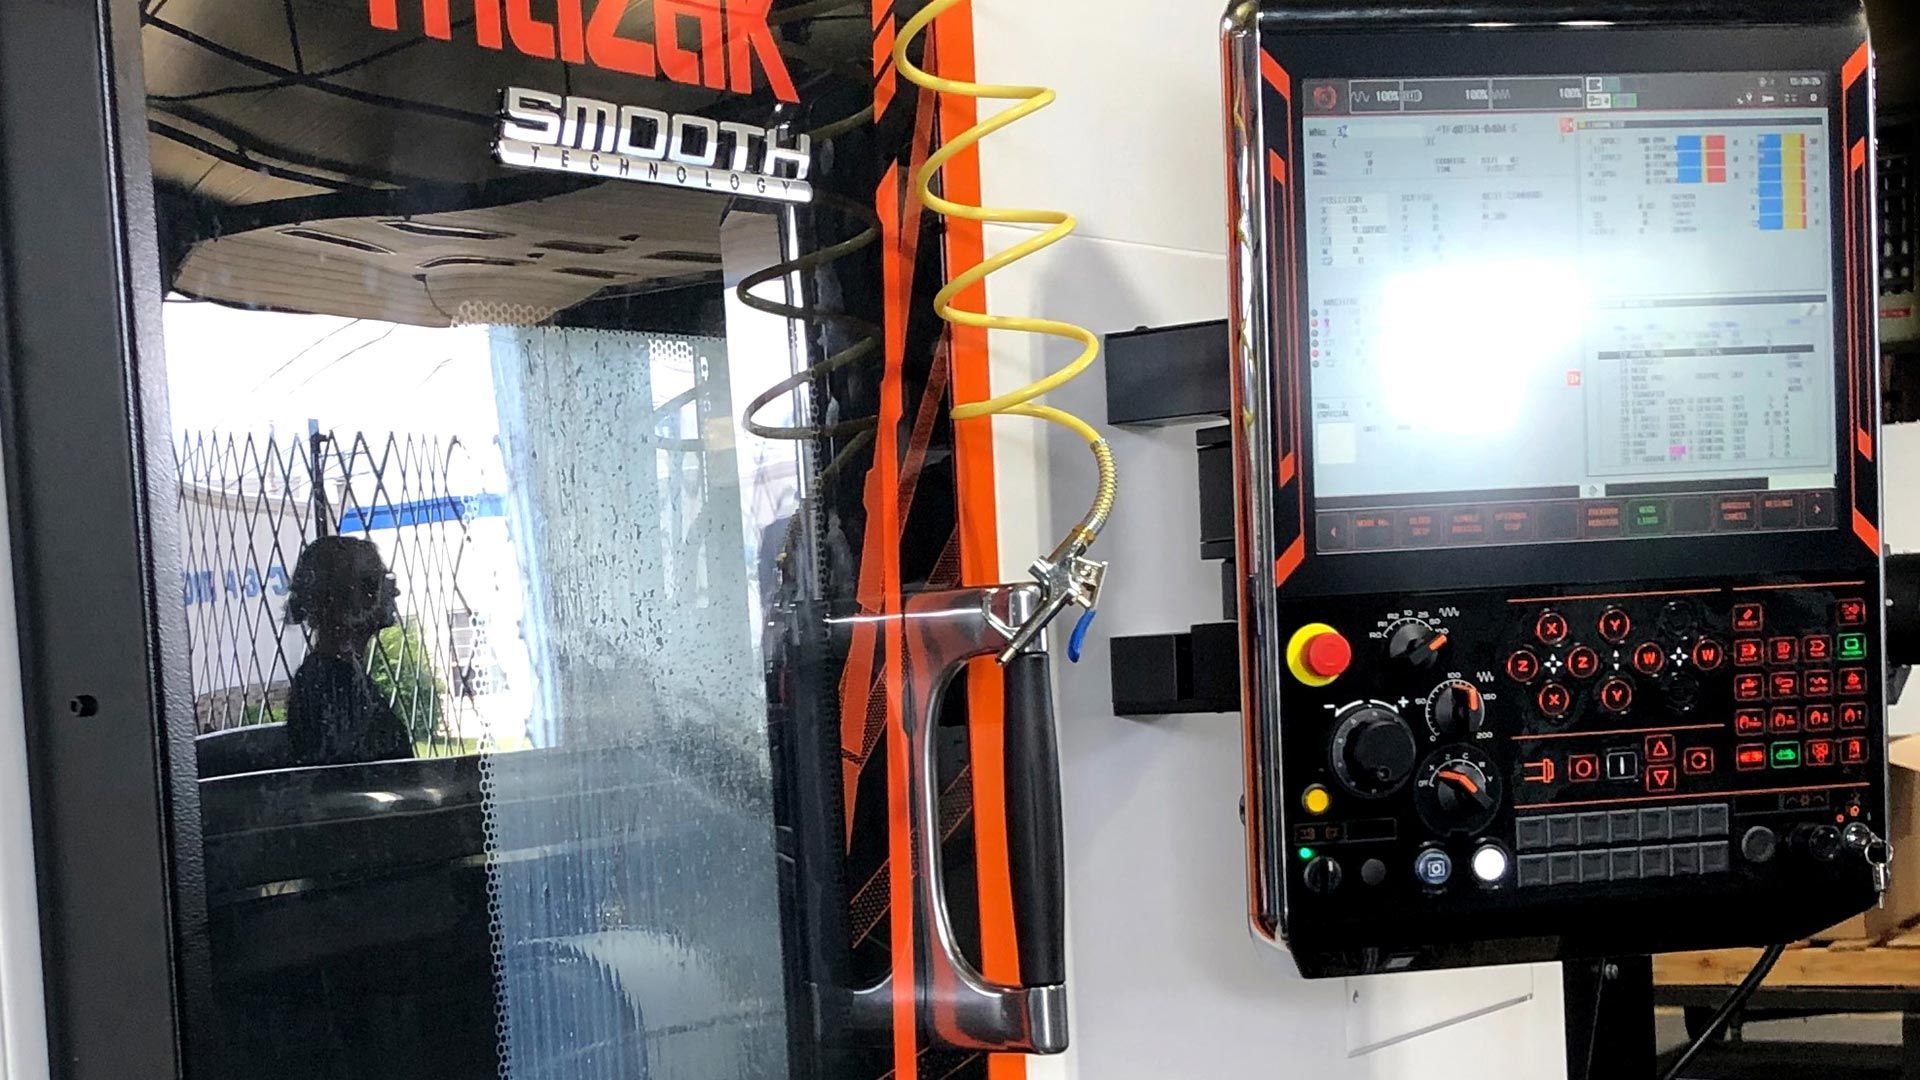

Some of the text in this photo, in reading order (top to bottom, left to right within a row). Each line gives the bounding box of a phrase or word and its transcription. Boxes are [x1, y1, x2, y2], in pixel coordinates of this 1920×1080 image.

[503, 86, 811, 180] SMOOTH
[530, 144, 792, 194] TECHNOLOGY
[1546, 622, 1557, 635] X
[1609, 619, 1621, 632] Y
[1642, 652, 1656, 665] W
[1702, 648, 1714, 661] W
[1517, 660, 1529, 672] Z
[1577, 656, 1588, 668] Z
[1447, 671, 1462, 679] 100
[1482, 693, 1497, 701] 150
[1548, 693, 1560, 706] X
[1611, 689, 1623, 702] Y
[1475, 731, 1493, 740] 200
